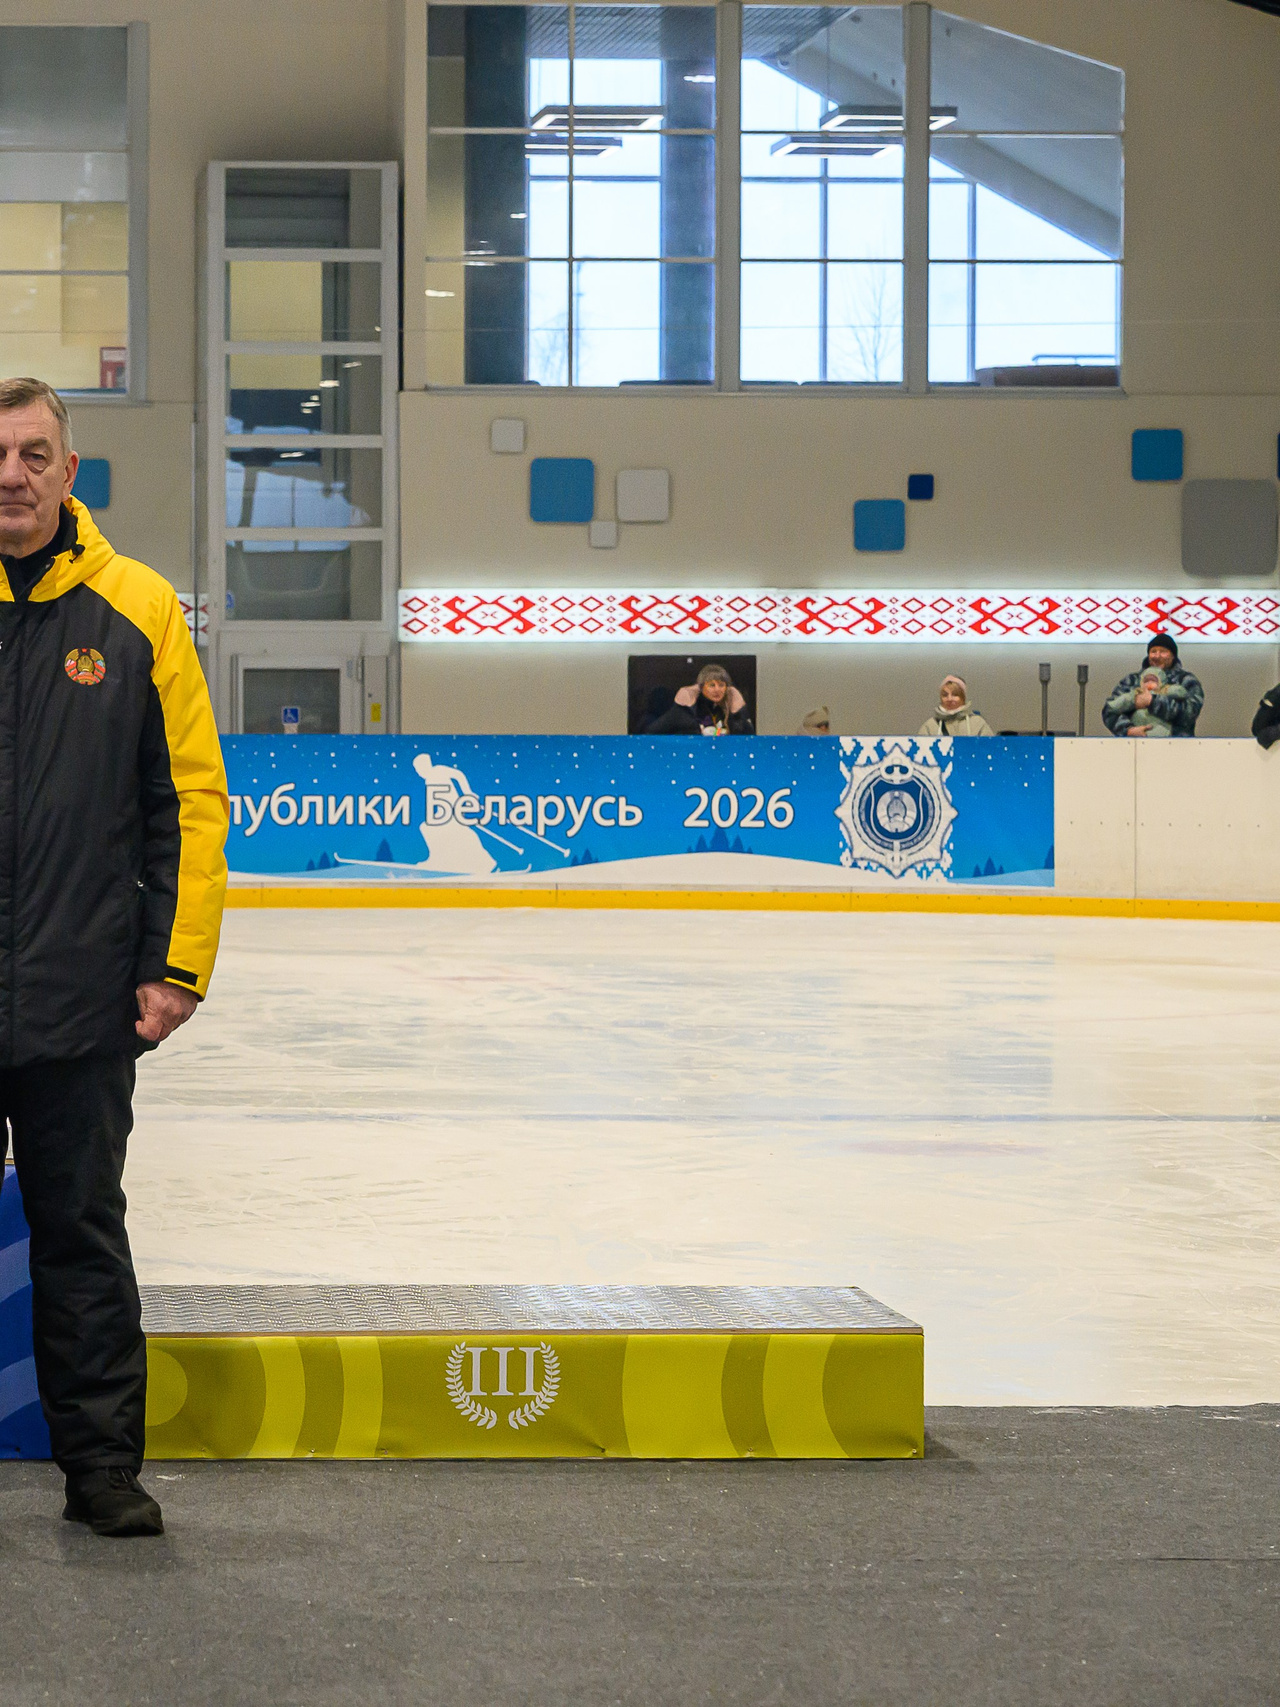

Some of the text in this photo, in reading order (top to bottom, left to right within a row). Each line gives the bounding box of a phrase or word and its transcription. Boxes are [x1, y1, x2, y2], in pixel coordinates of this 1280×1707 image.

[425, 784, 644, 837] Беларусь
[683, 786, 795, 829] 2026
[466, 1347, 541, 1395] III
